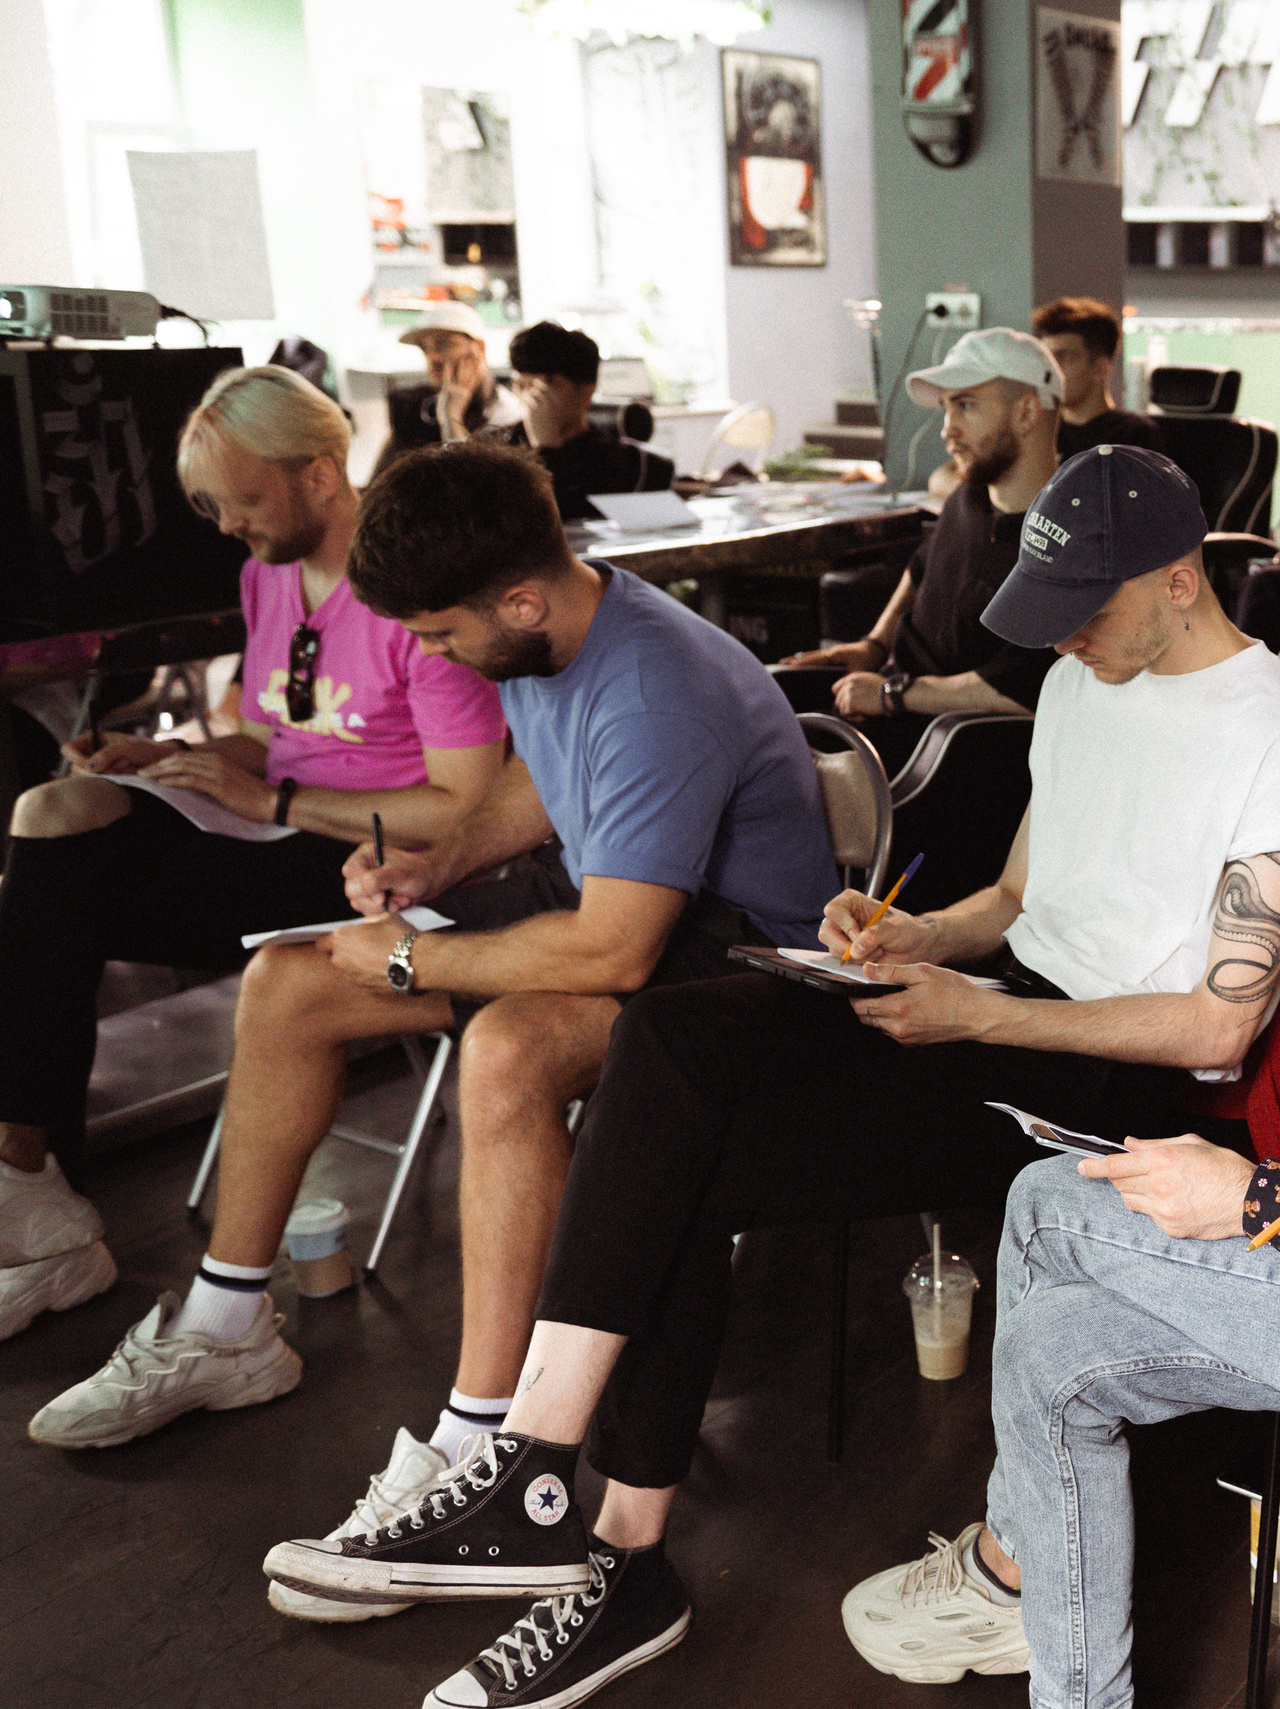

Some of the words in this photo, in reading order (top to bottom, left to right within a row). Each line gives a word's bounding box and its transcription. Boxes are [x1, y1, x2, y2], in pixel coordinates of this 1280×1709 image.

[532, 1477, 563, 1495] CONVERSE
[531, 1508, 542, 1520] ALL
[544, 1510, 560, 1522] STAR
